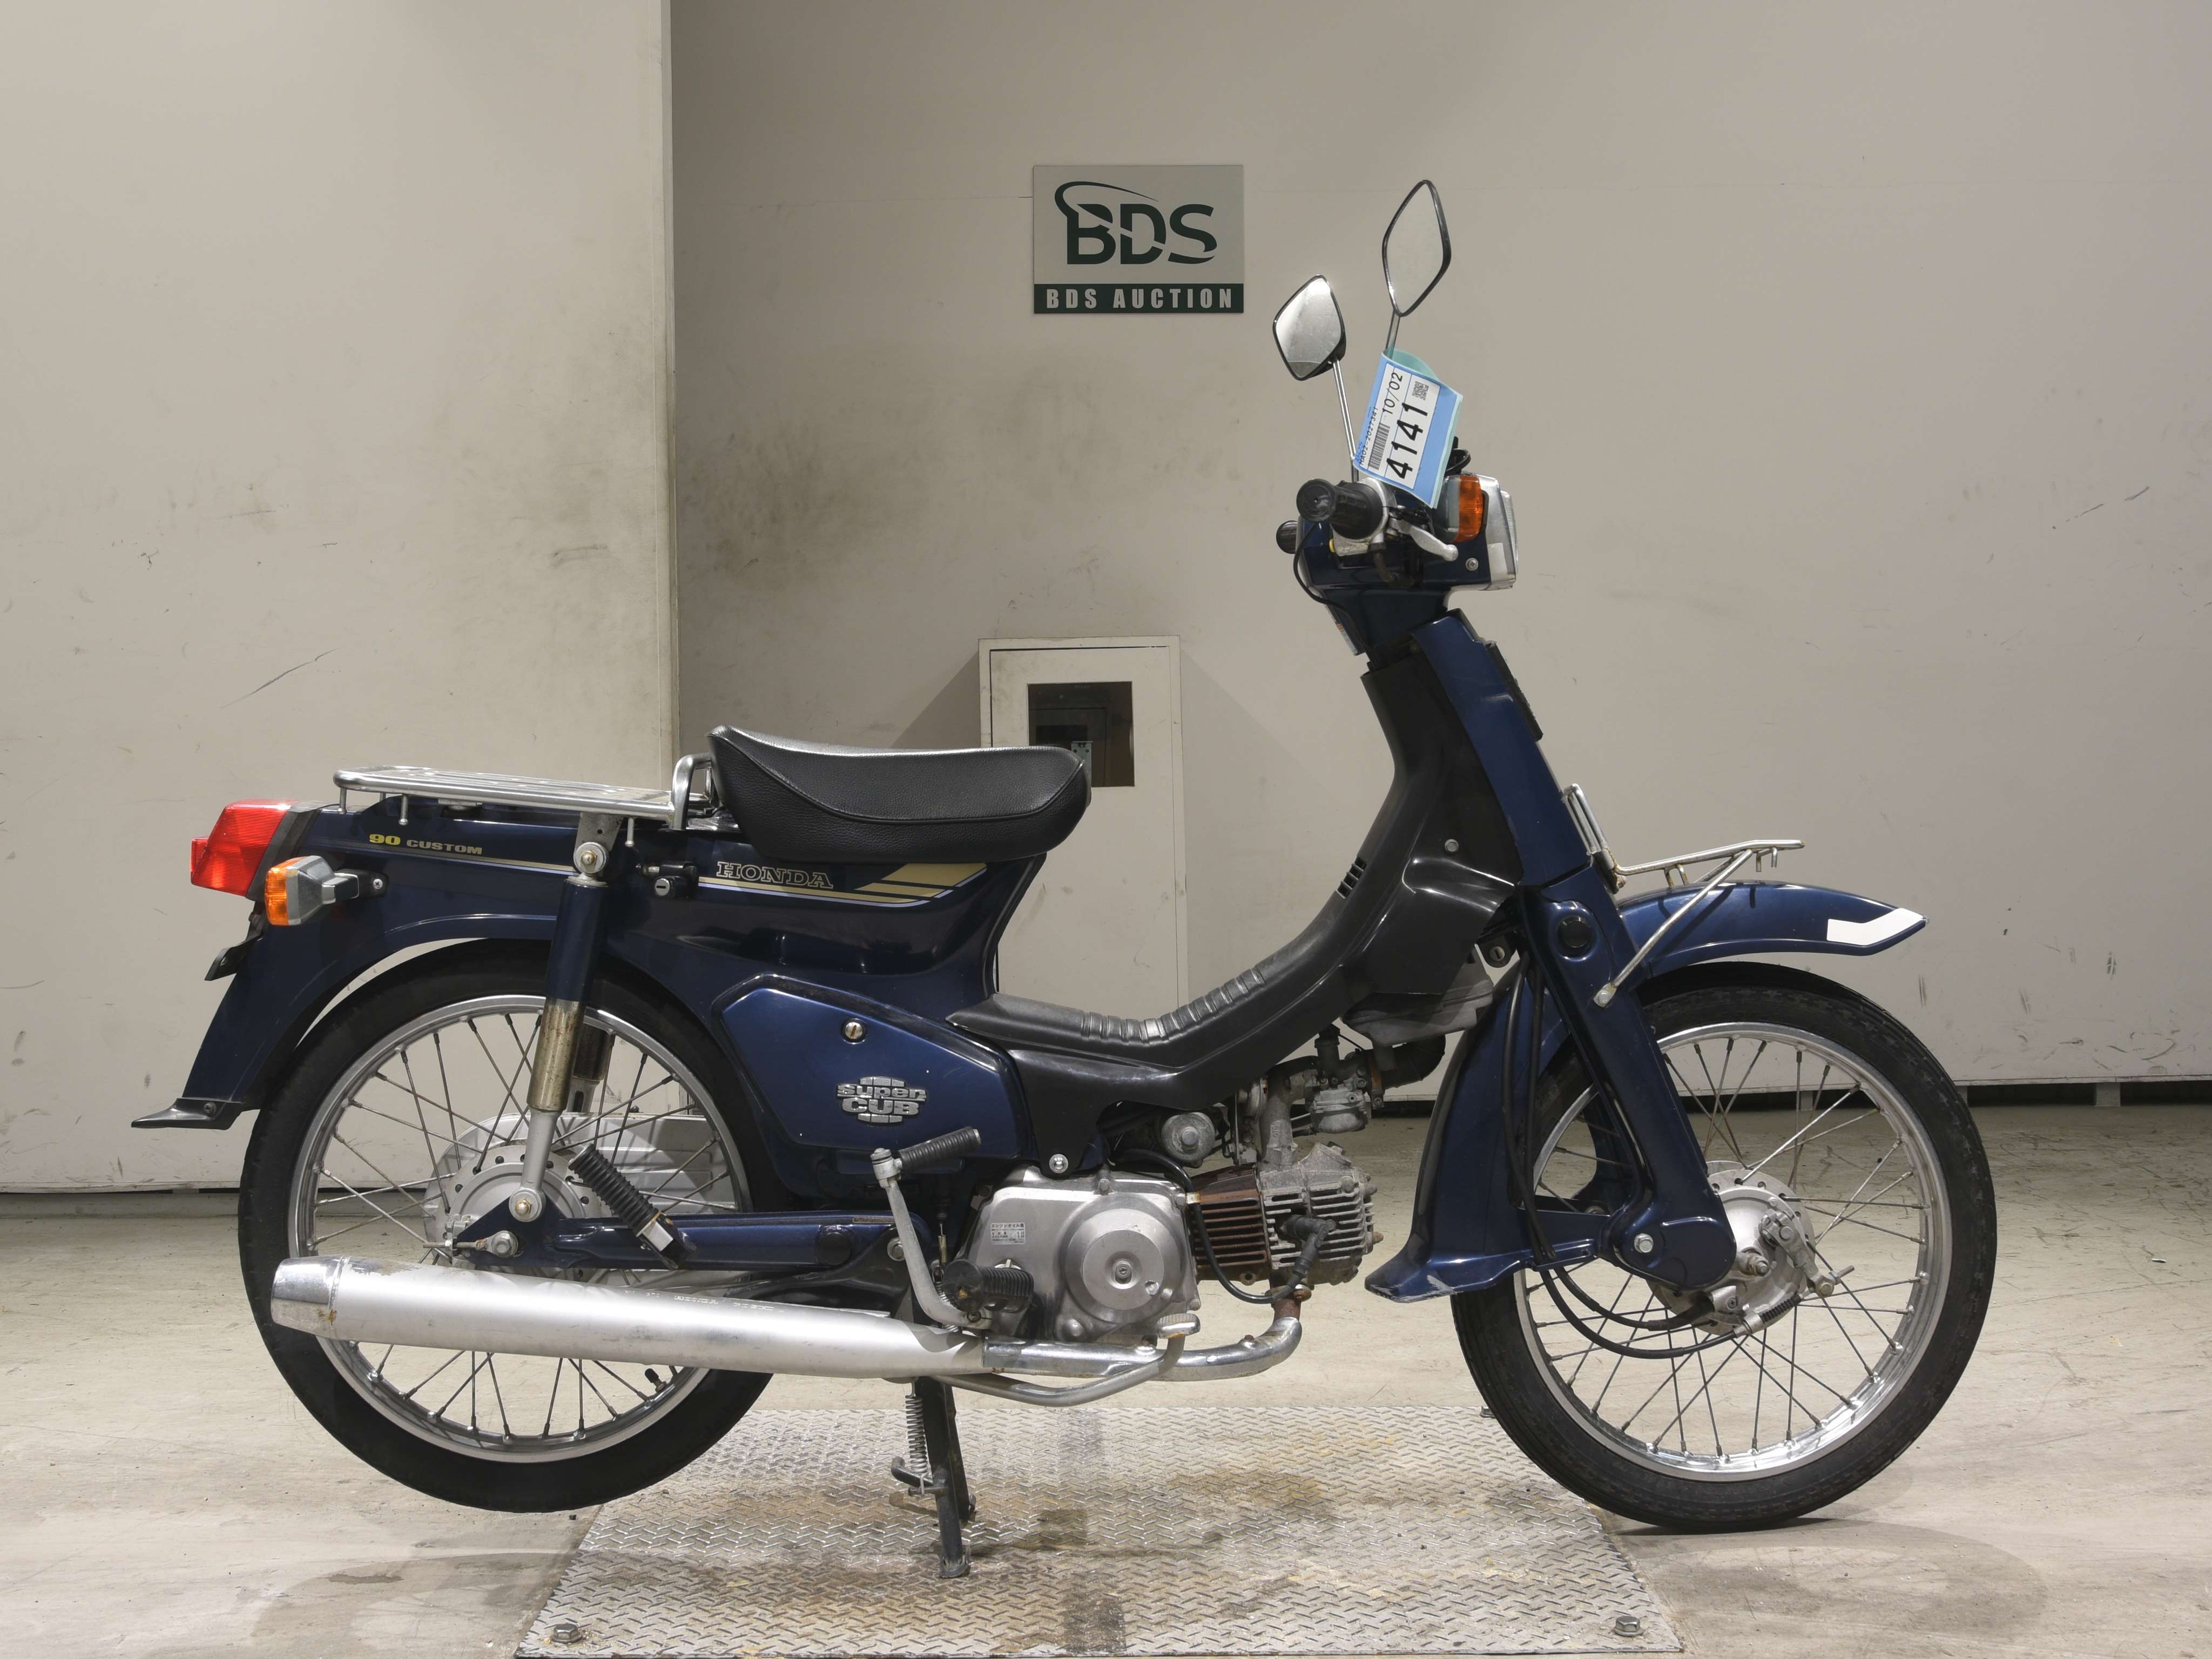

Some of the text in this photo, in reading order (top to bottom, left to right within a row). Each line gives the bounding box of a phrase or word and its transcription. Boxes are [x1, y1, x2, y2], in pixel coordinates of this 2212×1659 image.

[1055, 182, 1217, 265] BDS
[1047, 288, 1232, 309] BDS AUCTION
[1382, 372, 1403, 414] 10/02
[1386, 402, 1428, 480] 4141
[369, 834, 483, 855] 90 CUSTOM
[716, 861, 833, 889] HONDA
[842, 1097, 919, 1115] CUB
